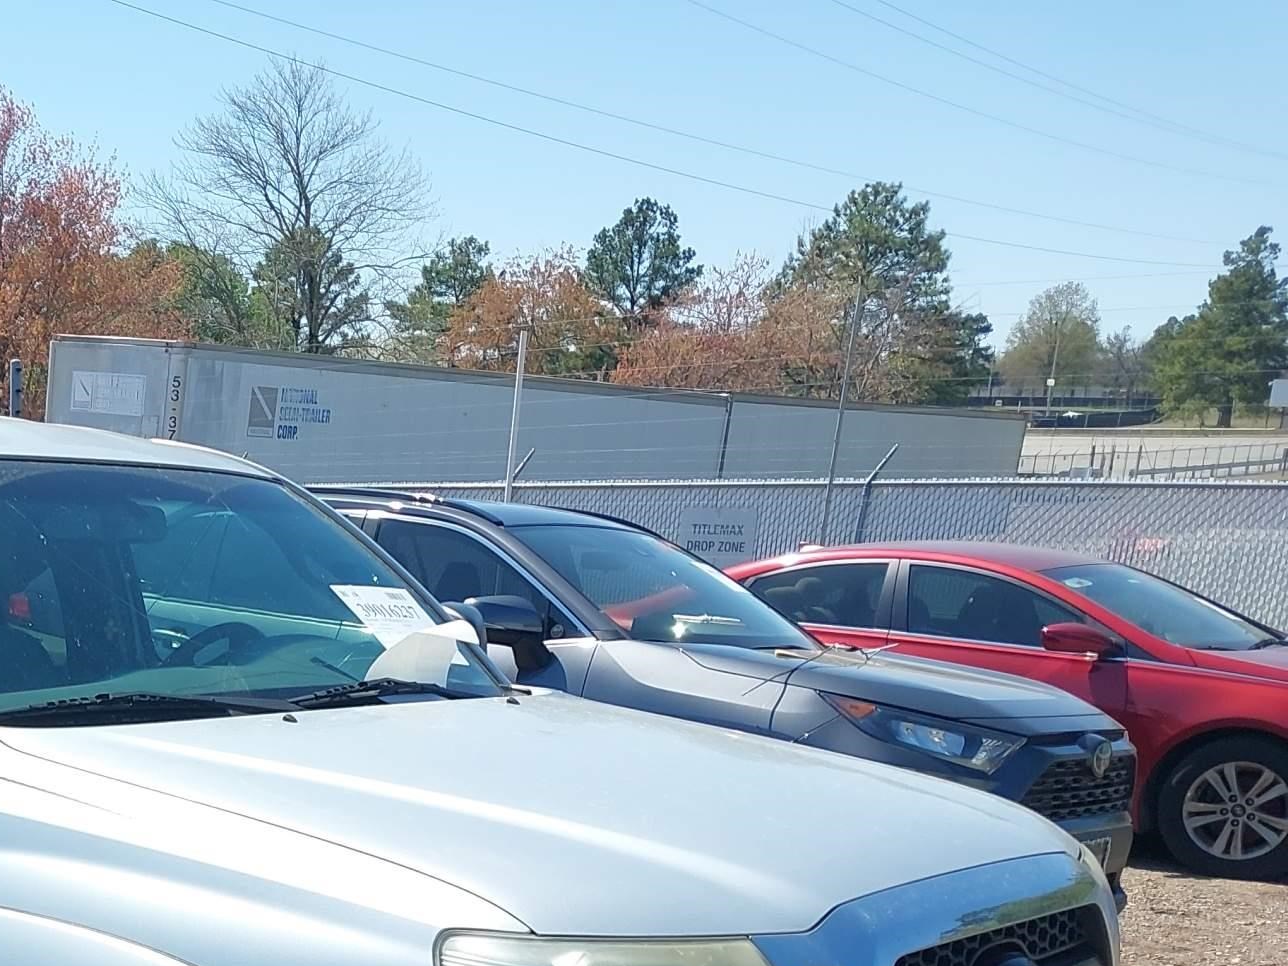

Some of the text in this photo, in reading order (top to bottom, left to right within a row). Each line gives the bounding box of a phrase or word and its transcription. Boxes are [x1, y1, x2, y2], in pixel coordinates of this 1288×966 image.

[276, 424, 299, 441] CORP.
[692, 523, 744, 537] TITLEMAX
[686, 540, 746, 554] DROP ZONE
